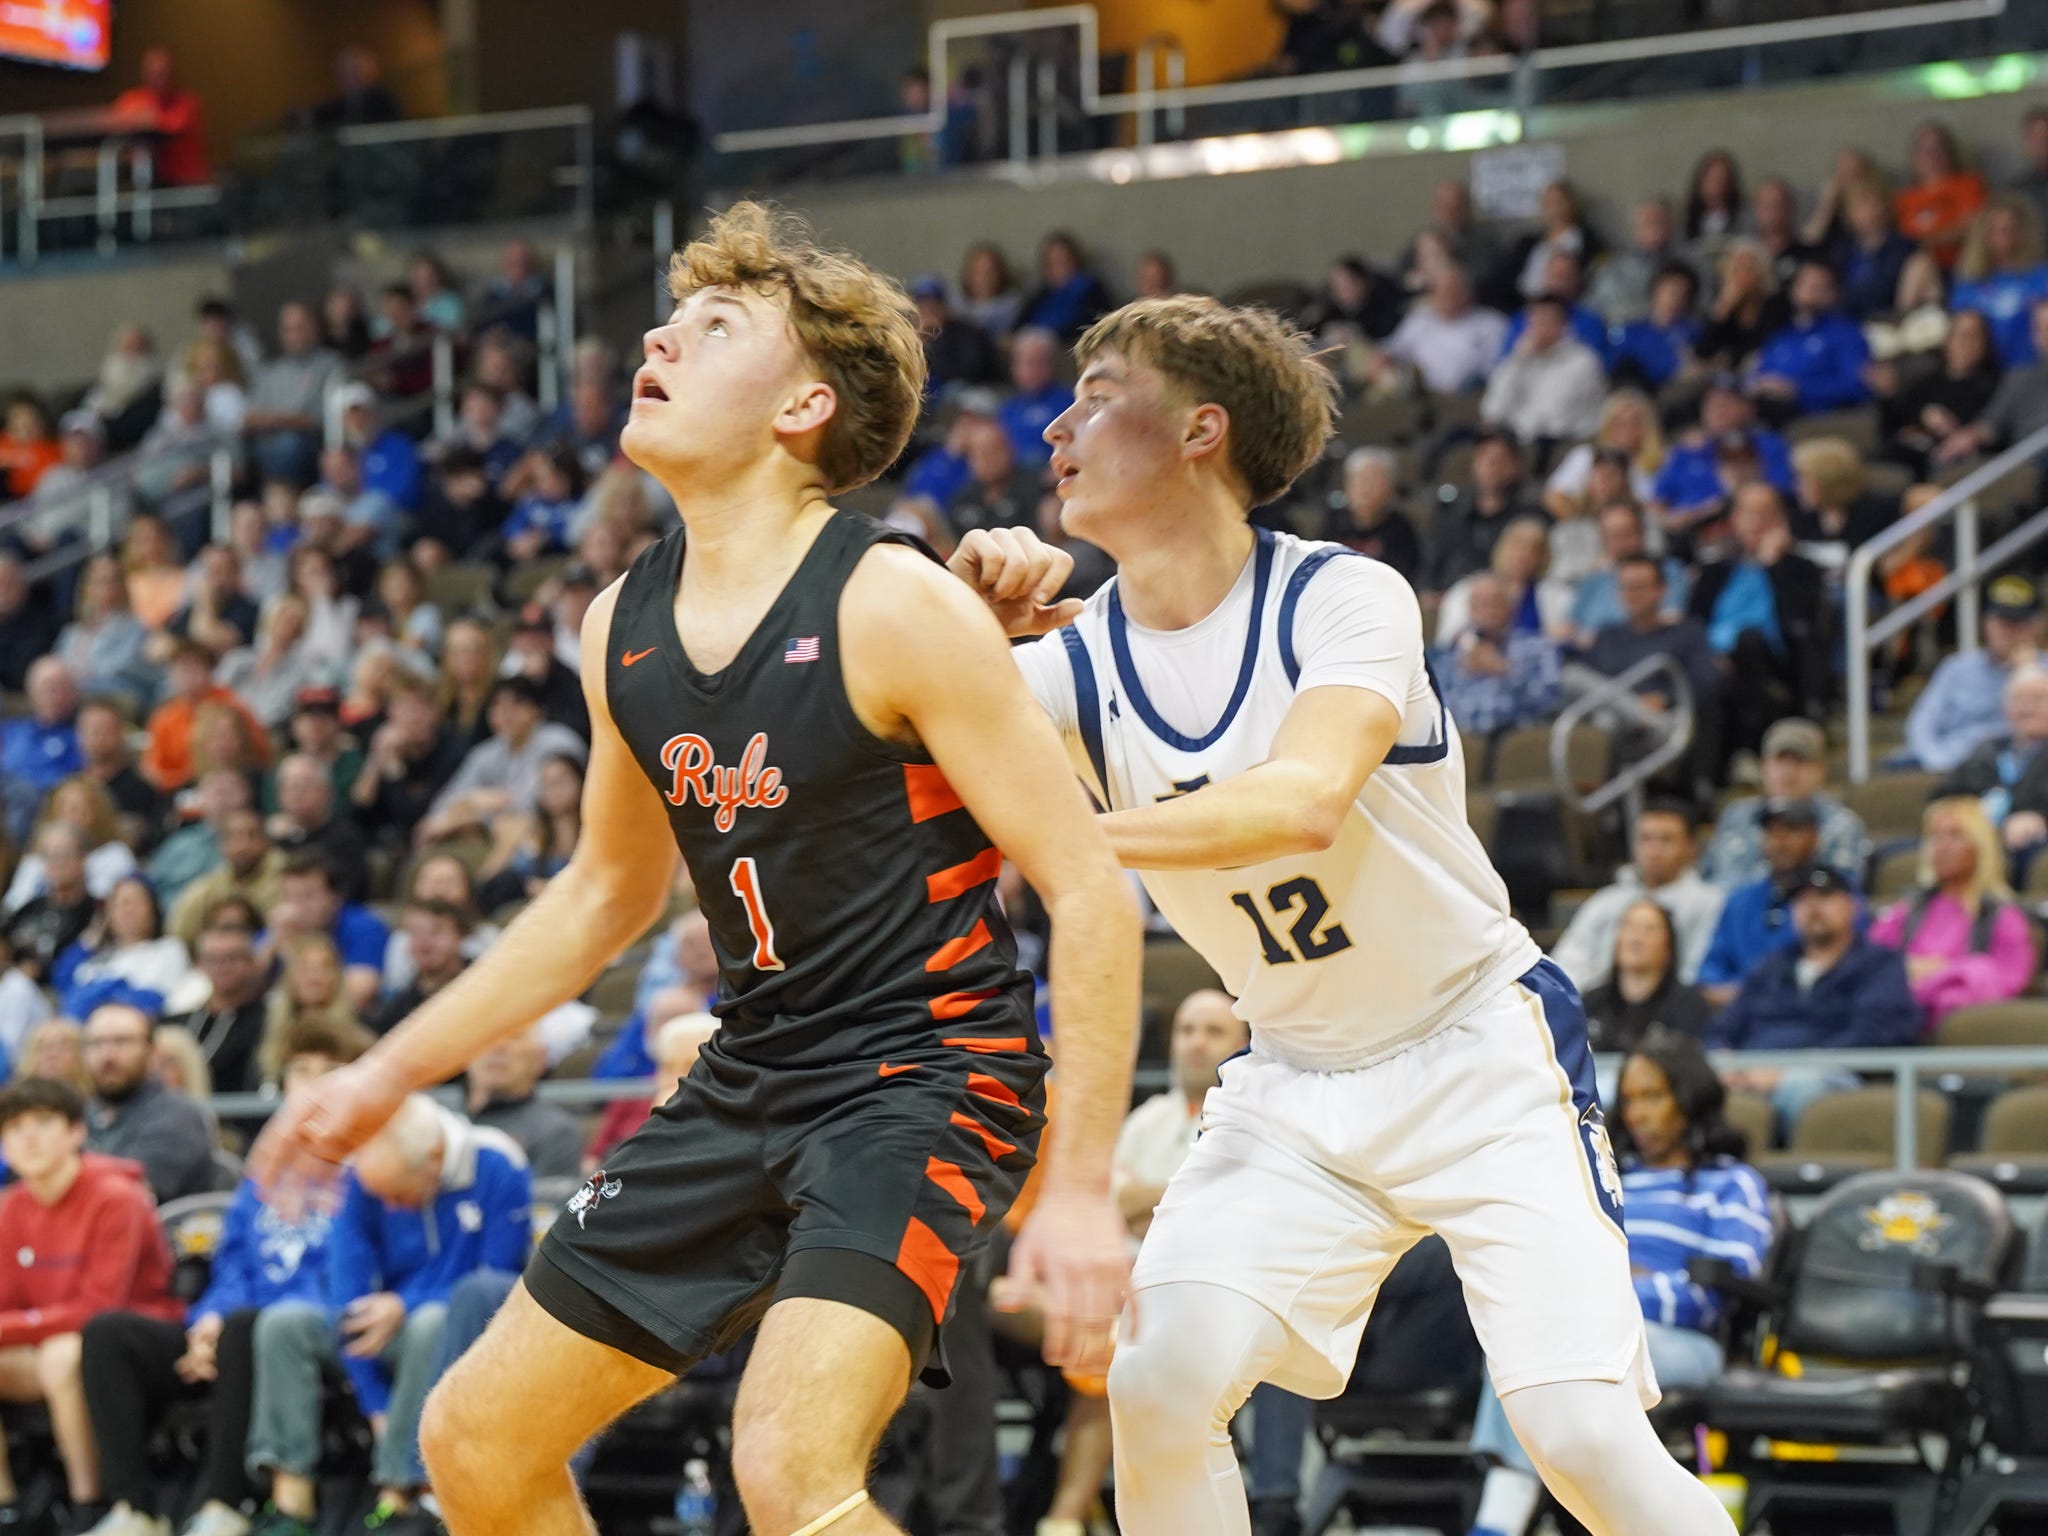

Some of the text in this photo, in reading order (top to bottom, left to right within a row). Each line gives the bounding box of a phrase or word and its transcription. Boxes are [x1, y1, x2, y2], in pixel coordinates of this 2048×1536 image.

[660, 732, 789, 833] Ryle
[729, 857, 786, 972] 1
[1229, 874, 1354, 966] 12
